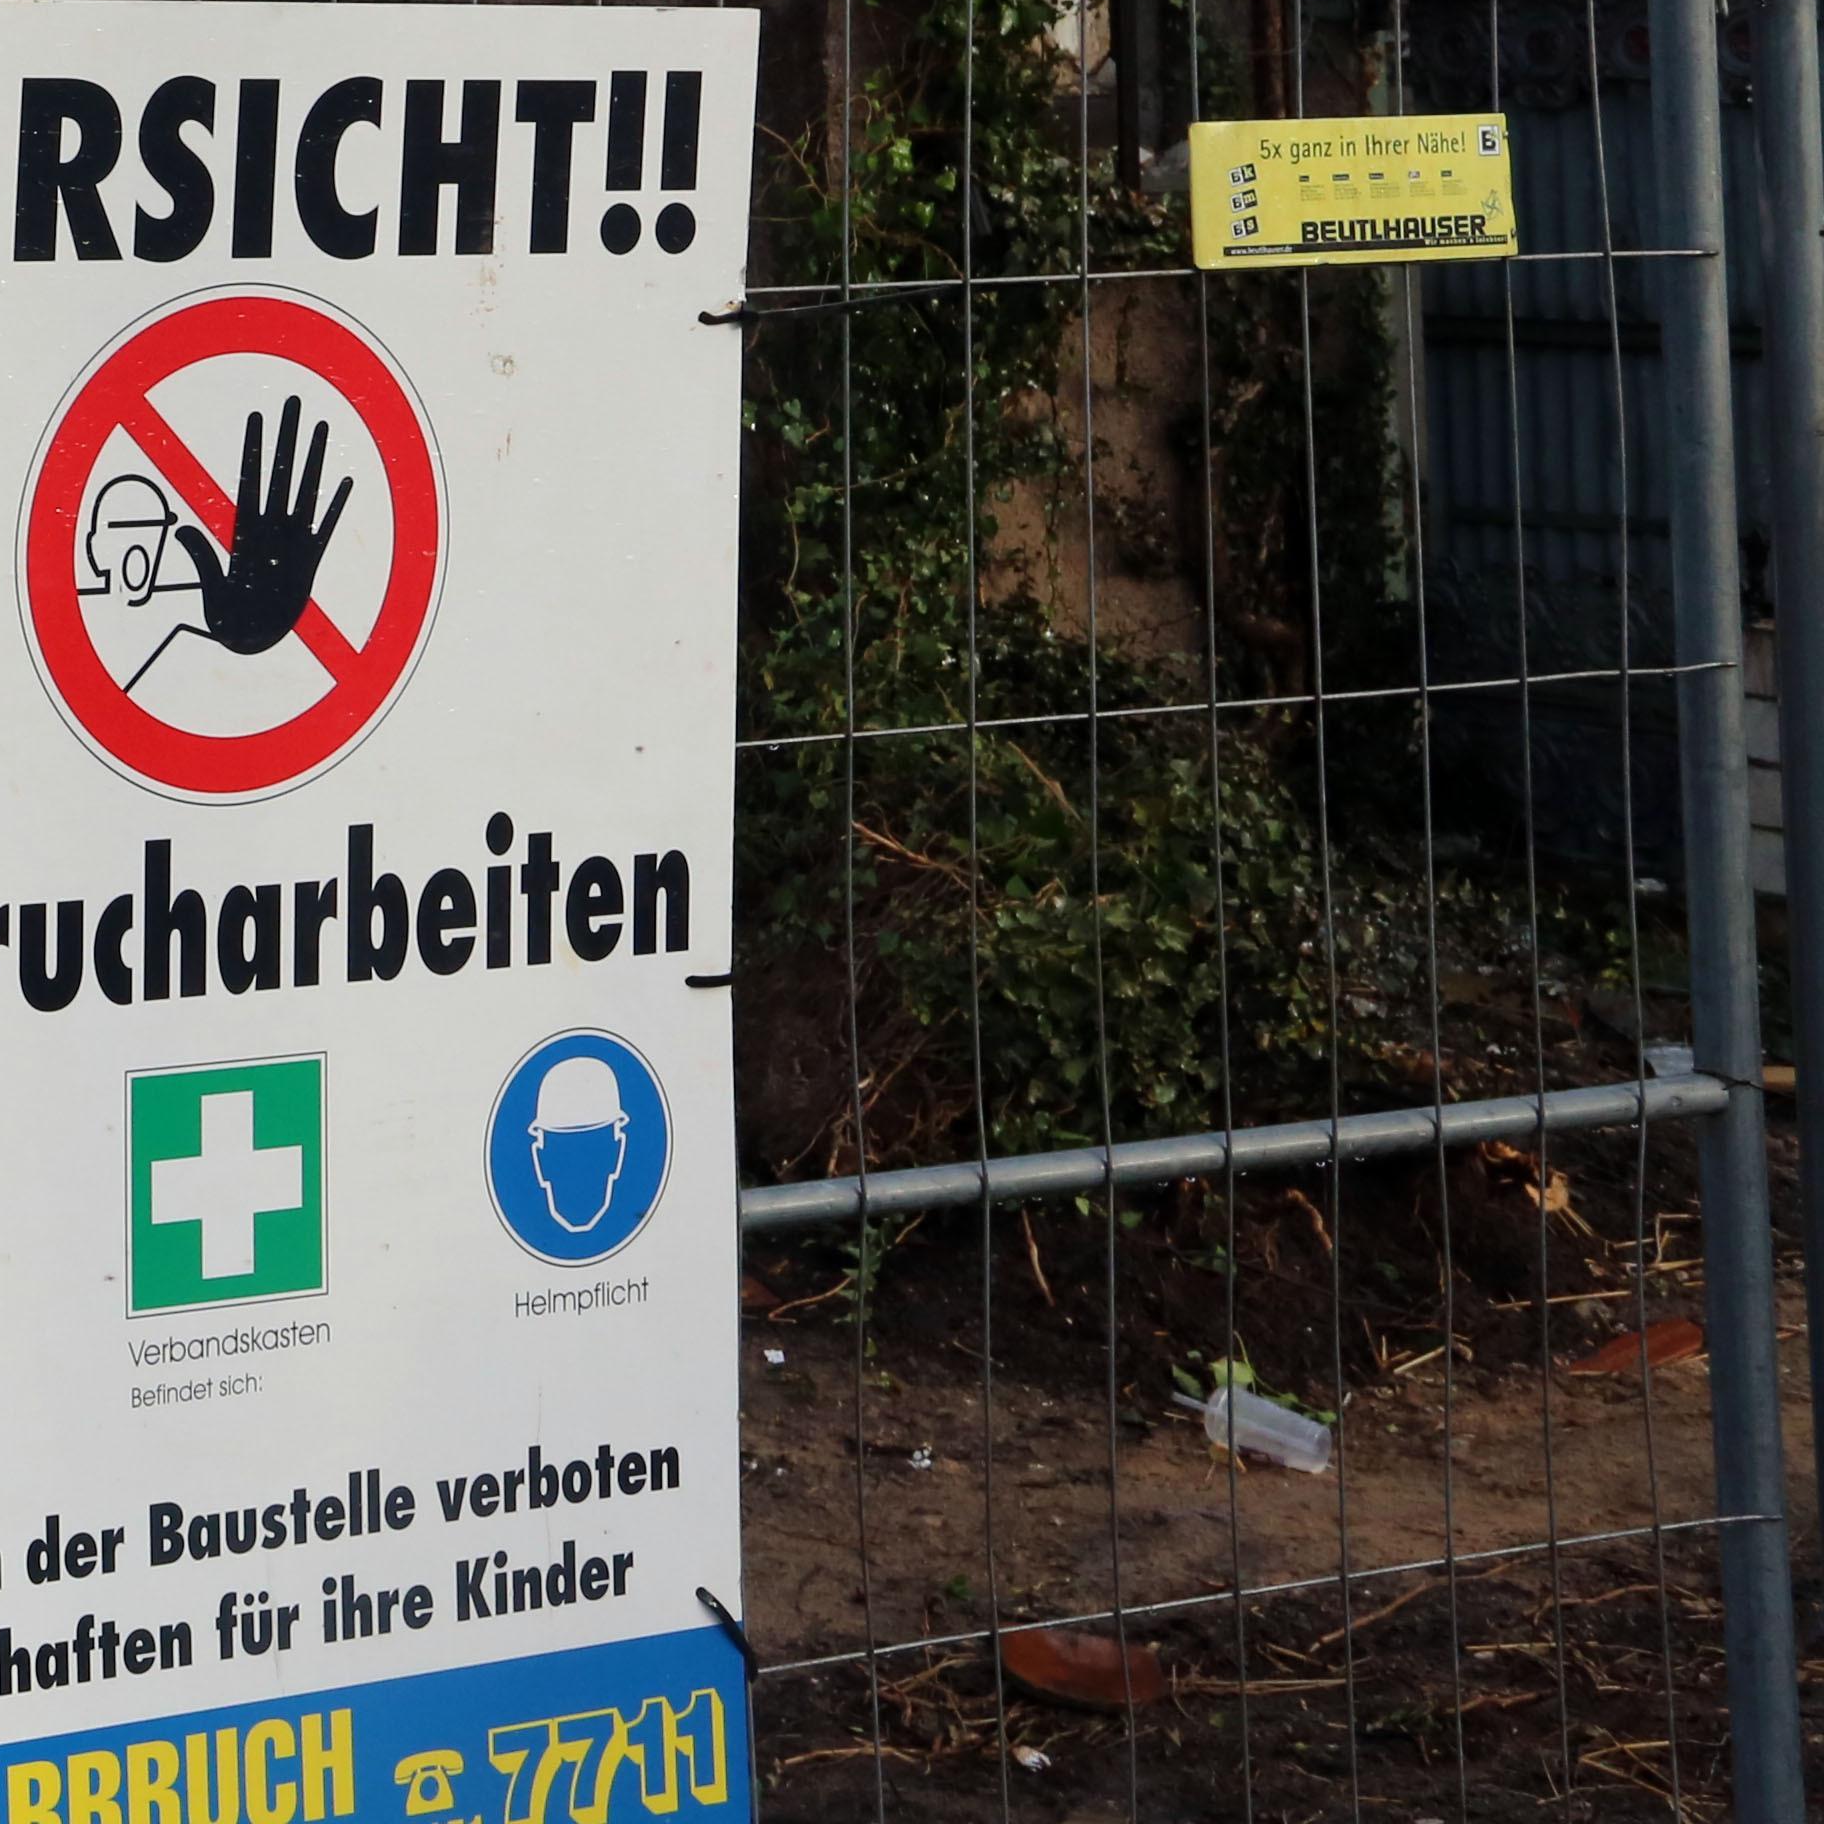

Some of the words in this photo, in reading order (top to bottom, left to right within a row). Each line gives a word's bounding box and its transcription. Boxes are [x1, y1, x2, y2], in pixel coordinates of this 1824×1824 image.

[1260, 139, 1282, 159] 5x
[1290, 140, 1332, 164] ganz
[1340, 135, 1356, 157] in
[1365, 134, 1409, 156] Ihrer
[1417, 132, 1466, 154] Nähe!
[1302, 215, 1487, 242] BEUTLHAUSER
[515, 1276, 649, 1318] Helmpflicht
[128, 1321, 331, 1367] Verbandskasten
[131, 1378, 213, 1409] Befindet
[219, 1373, 264, 1397] sich:
[27, 1514, 125, 1584] der
[150, 1469, 416, 1567] Baustelle
[436, 1445, 680, 1522] verboten
[215, 1592, 300, 1659] für
[323, 1575, 434, 1643] ihre
[457, 1541, 634, 1622] Kinder
[488, 1688, 727, 1824] 7711
